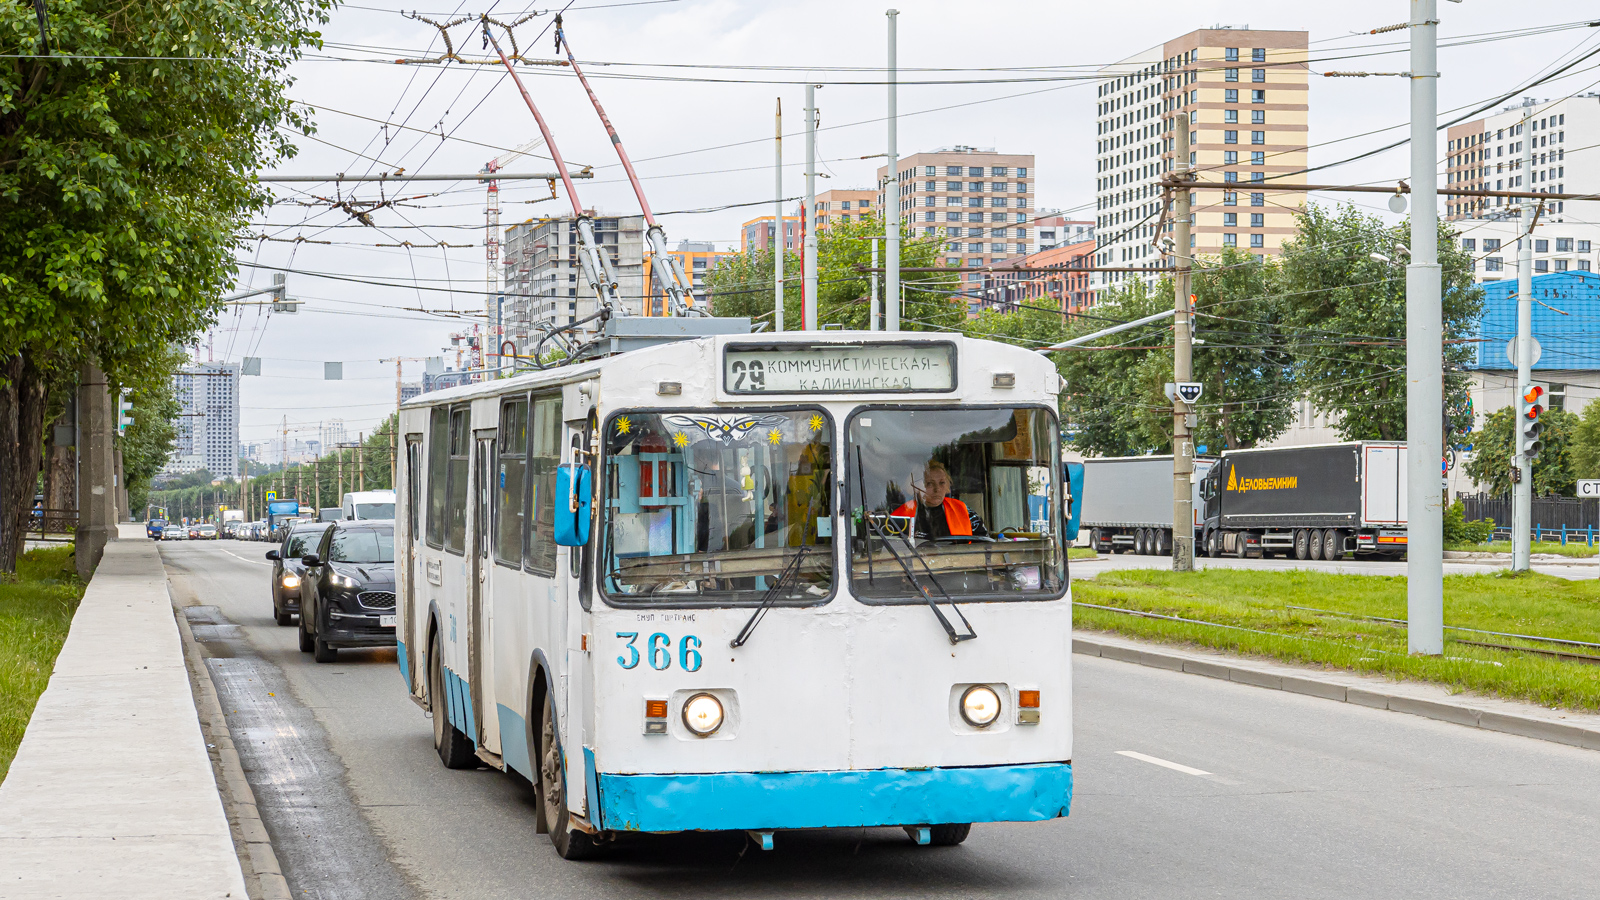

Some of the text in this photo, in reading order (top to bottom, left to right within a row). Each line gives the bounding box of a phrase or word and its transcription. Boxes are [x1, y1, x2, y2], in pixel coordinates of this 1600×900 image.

[768, 357, 939, 373] КОММУНИСТИЧЕСКАЯ-
[731, 360, 765, 390] 29
[800, 377, 911, 390] КАЛИНИНСКАЯ
[636, 614, 655, 622] ЕМУП
[615, 631, 702, 672] 366
